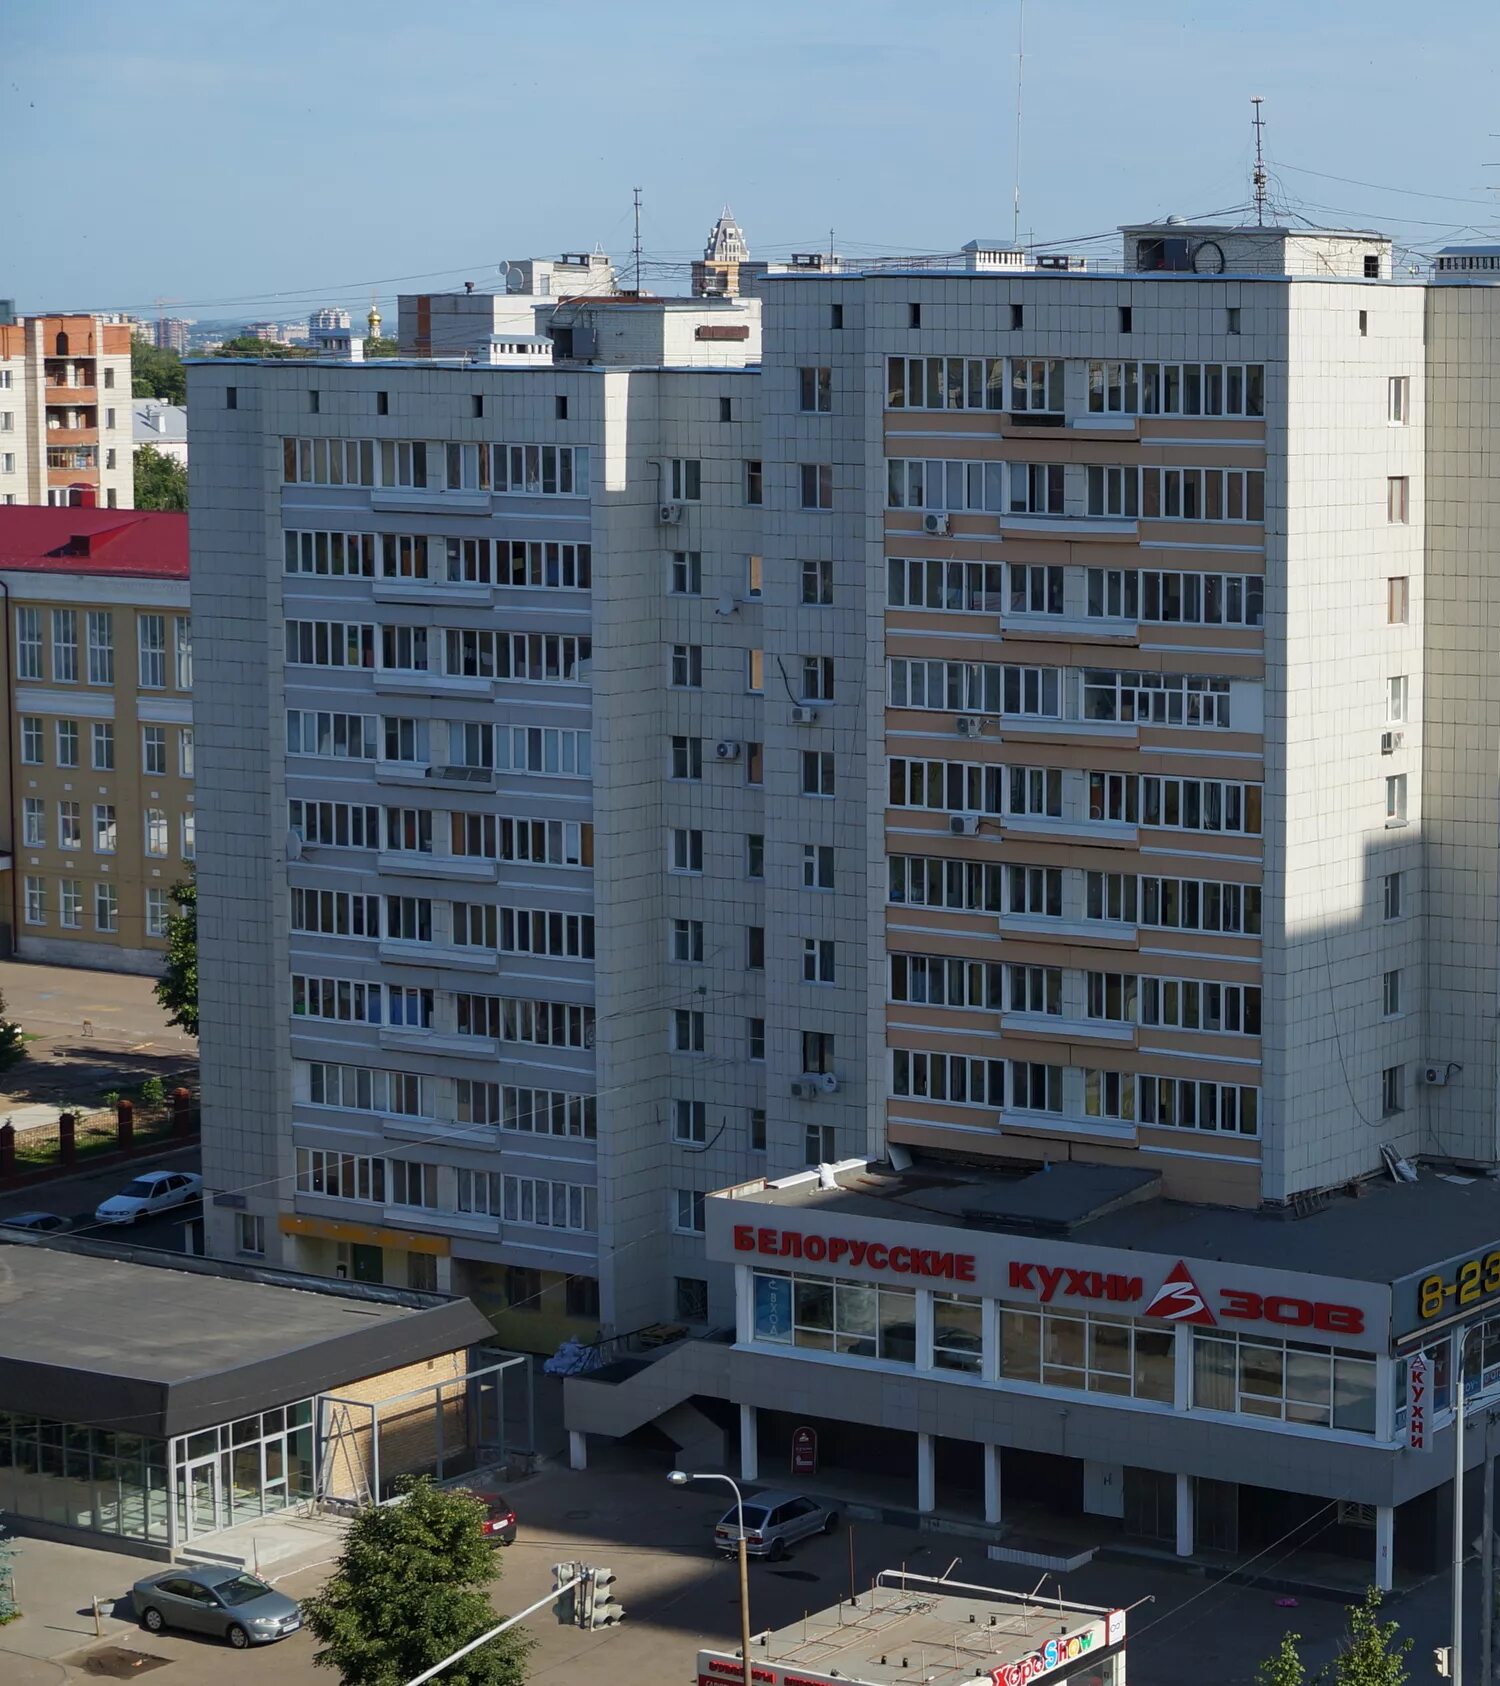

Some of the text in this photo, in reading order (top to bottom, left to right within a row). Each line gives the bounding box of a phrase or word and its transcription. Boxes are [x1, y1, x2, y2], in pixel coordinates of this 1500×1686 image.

[733, 1224, 1366, 1335] БЕЛОРУССКИЕ КУХНИ ЗОВ
[1411, 1370, 1425, 1449] КУХНИ
